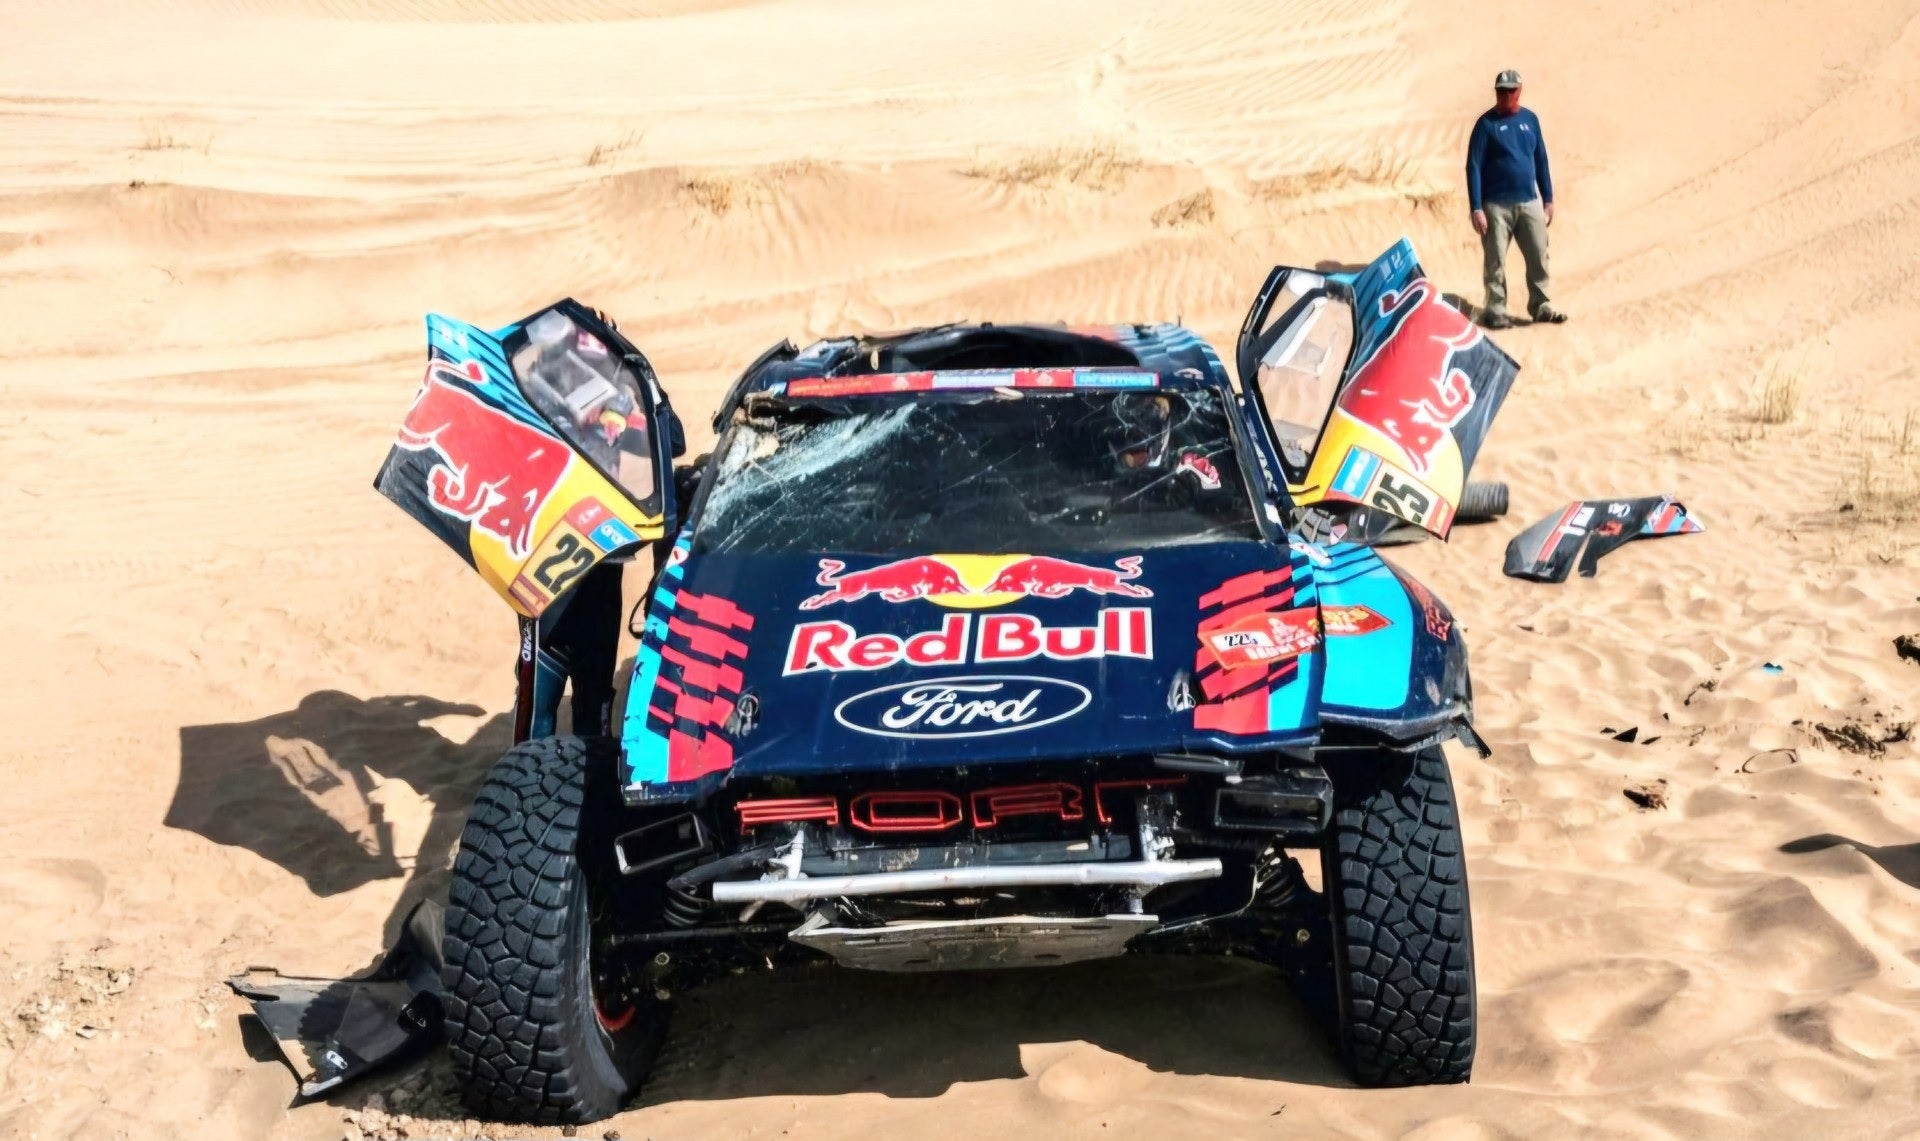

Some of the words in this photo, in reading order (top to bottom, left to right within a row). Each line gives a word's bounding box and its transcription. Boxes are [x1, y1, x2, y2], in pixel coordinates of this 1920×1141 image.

[533, 533, 596, 596] 22
[781, 611, 972, 678] Red
[973, 605, 1154, 665] Bull
[881, 681, 1043, 730] Ford
